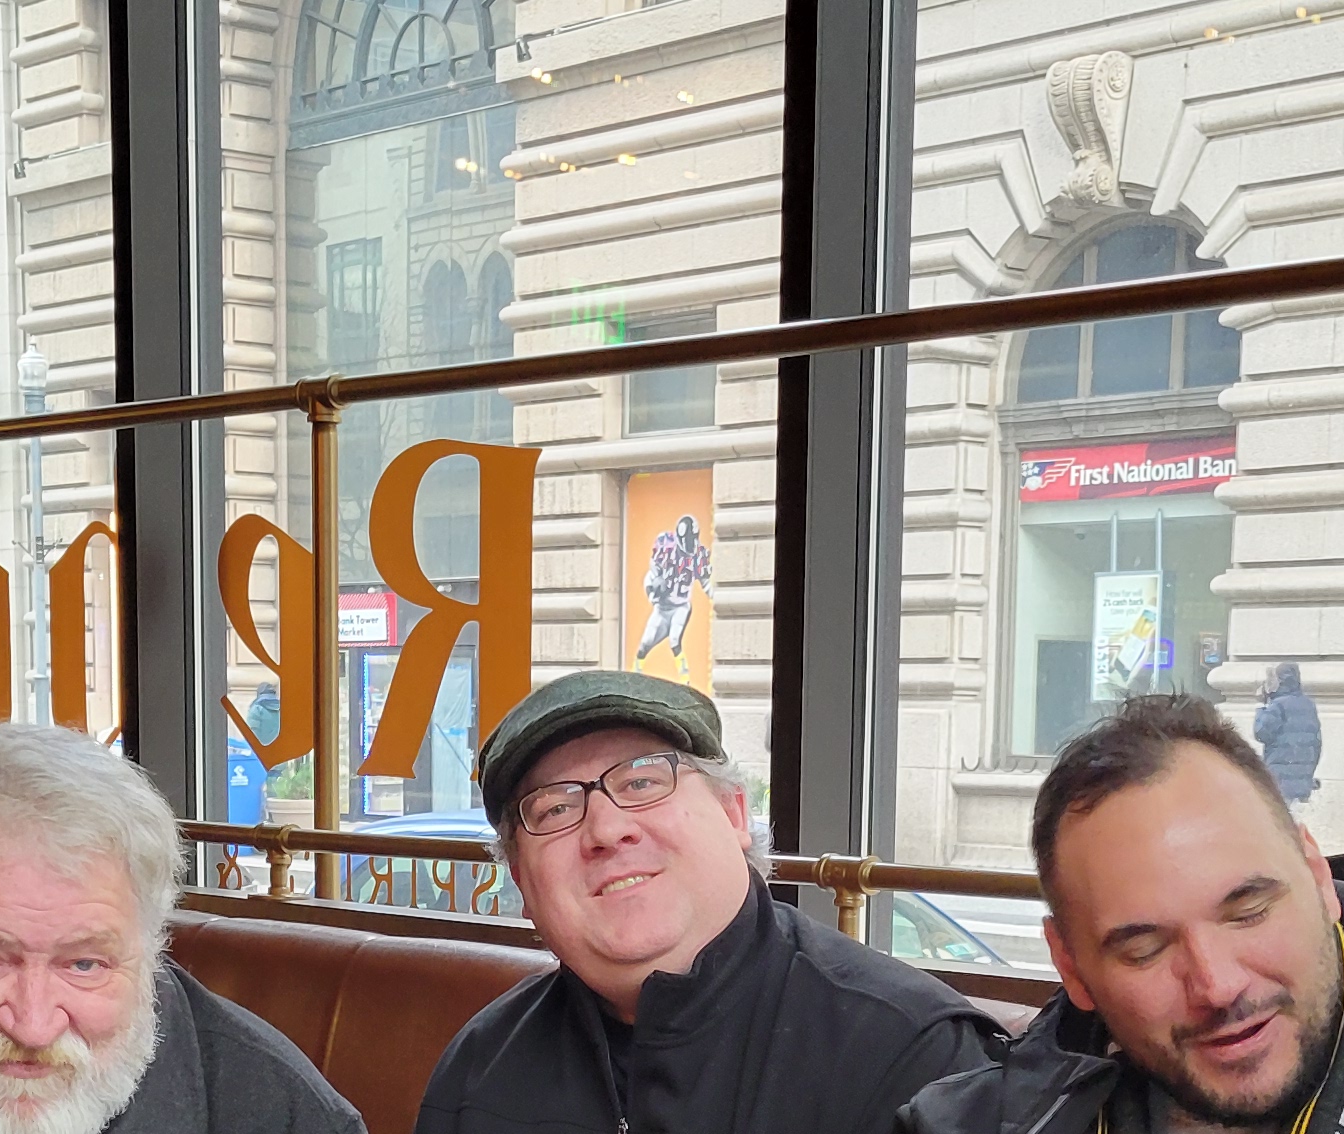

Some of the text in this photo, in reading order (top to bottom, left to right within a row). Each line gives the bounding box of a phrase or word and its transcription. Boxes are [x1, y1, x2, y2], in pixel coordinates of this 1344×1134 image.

[1069, 456, 1237, 486] First National Ban
[339, 614, 379, 625] ank Tower
